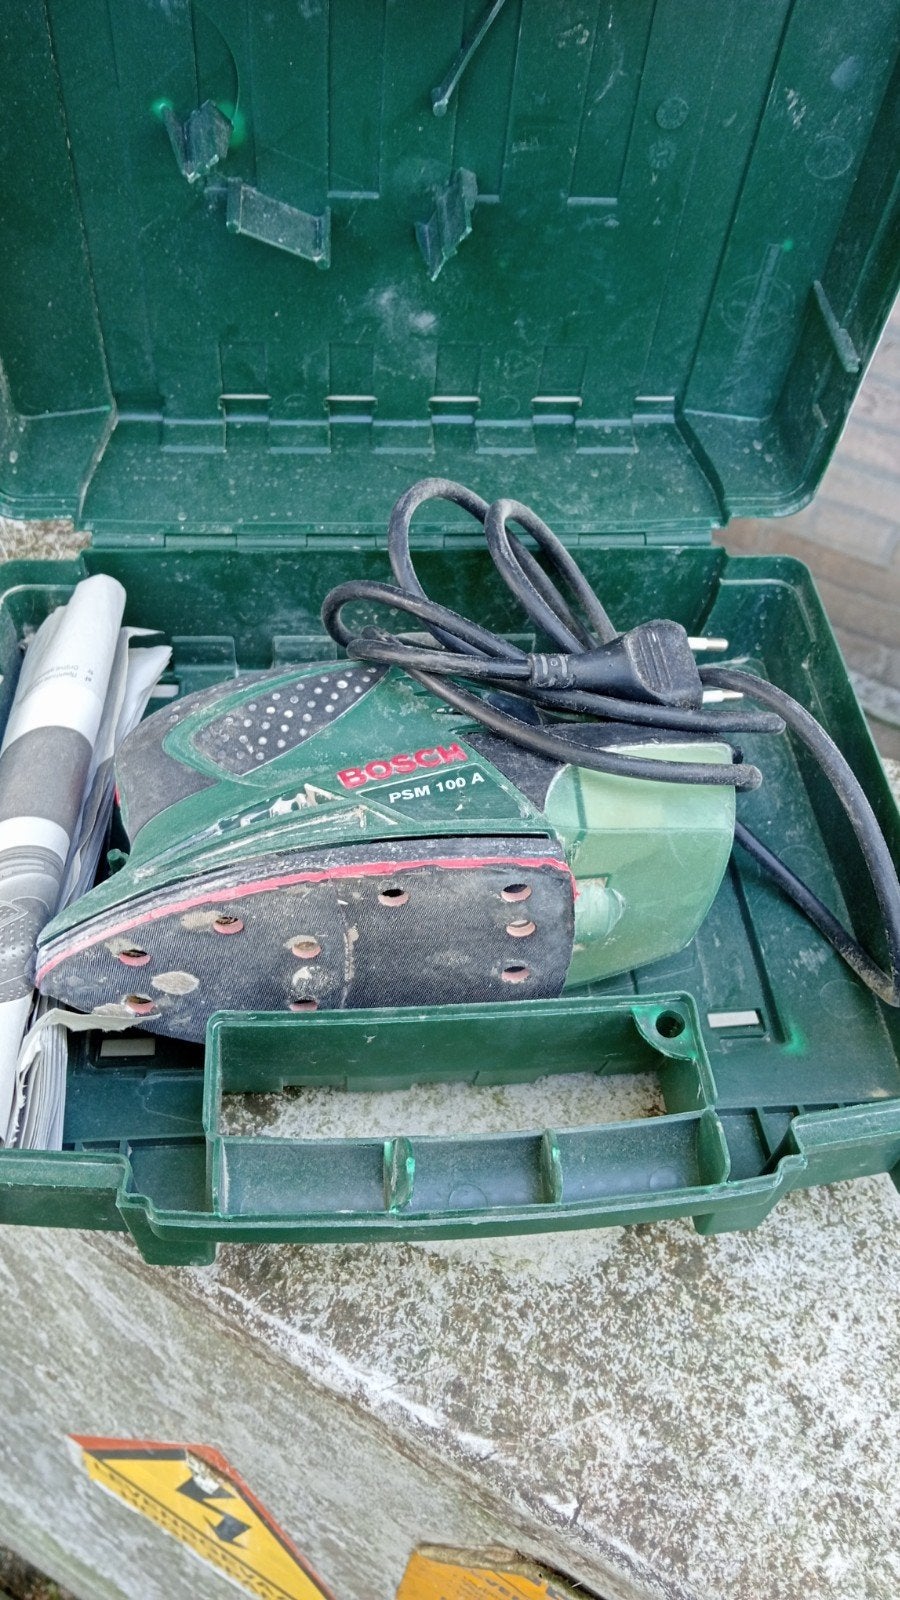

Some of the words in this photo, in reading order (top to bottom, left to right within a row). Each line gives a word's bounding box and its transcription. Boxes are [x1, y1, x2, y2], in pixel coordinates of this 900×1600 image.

[337, 742, 468, 789] BOSCH
[389, 785, 431, 803] PSM
[436, 777, 466, 793] 100
[471, 772, 485, 785] A
